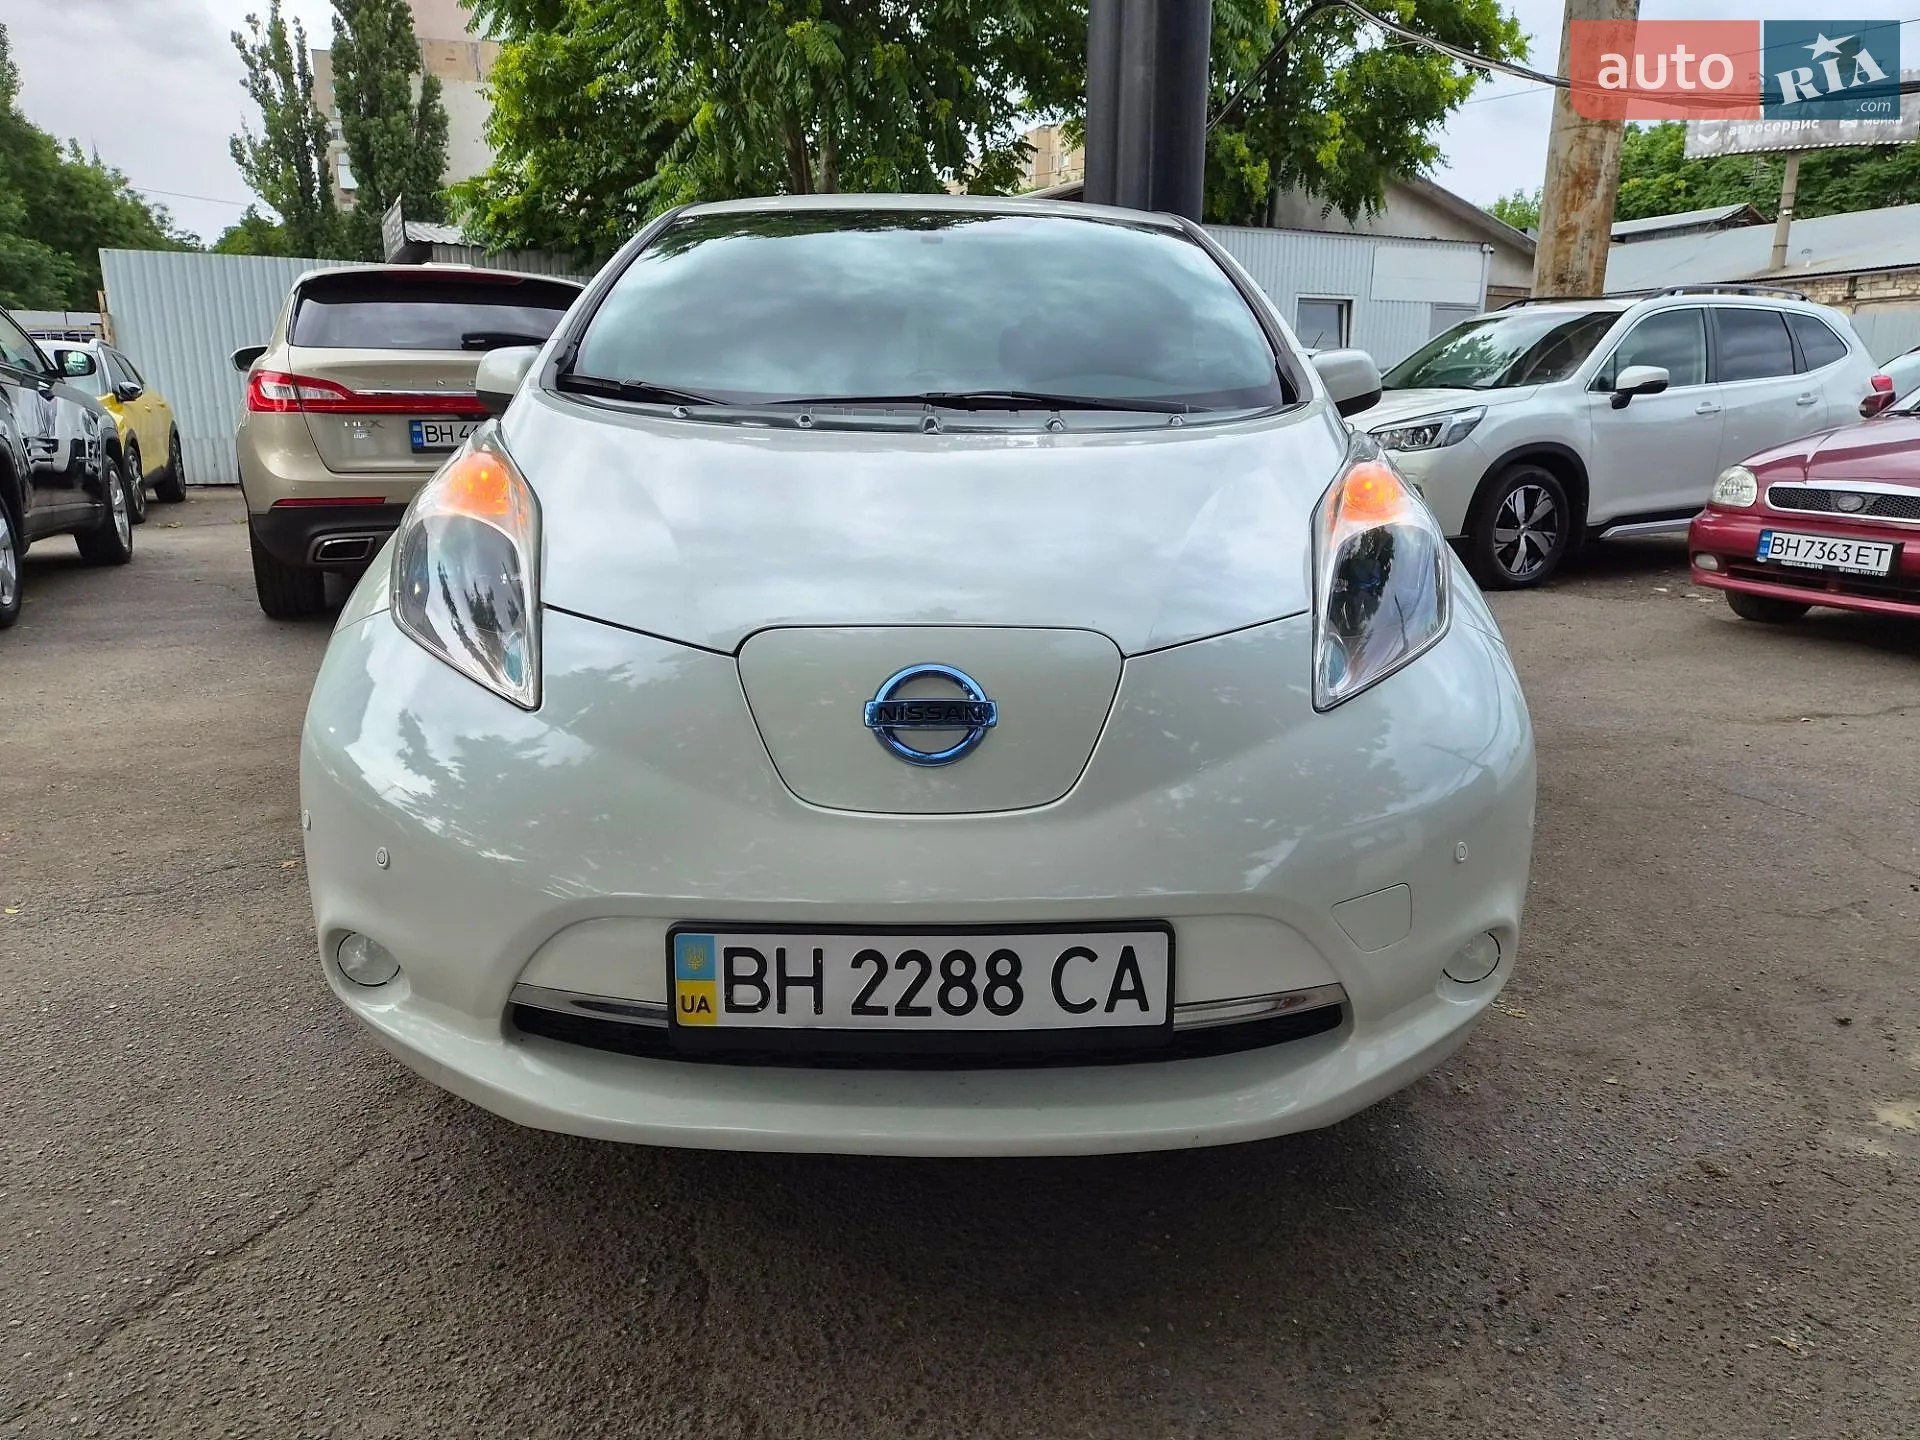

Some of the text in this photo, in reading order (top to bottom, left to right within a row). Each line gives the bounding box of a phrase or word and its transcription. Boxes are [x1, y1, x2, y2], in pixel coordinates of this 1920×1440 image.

[425, 424, 454, 443] BH
[1771, 536, 1889, 567] BH 7363 ET
[878, 705, 982, 722] NISSAN
[724, 945, 1150, 1017] BH 2288 CA
[681, 995, 711, 1013] UA
